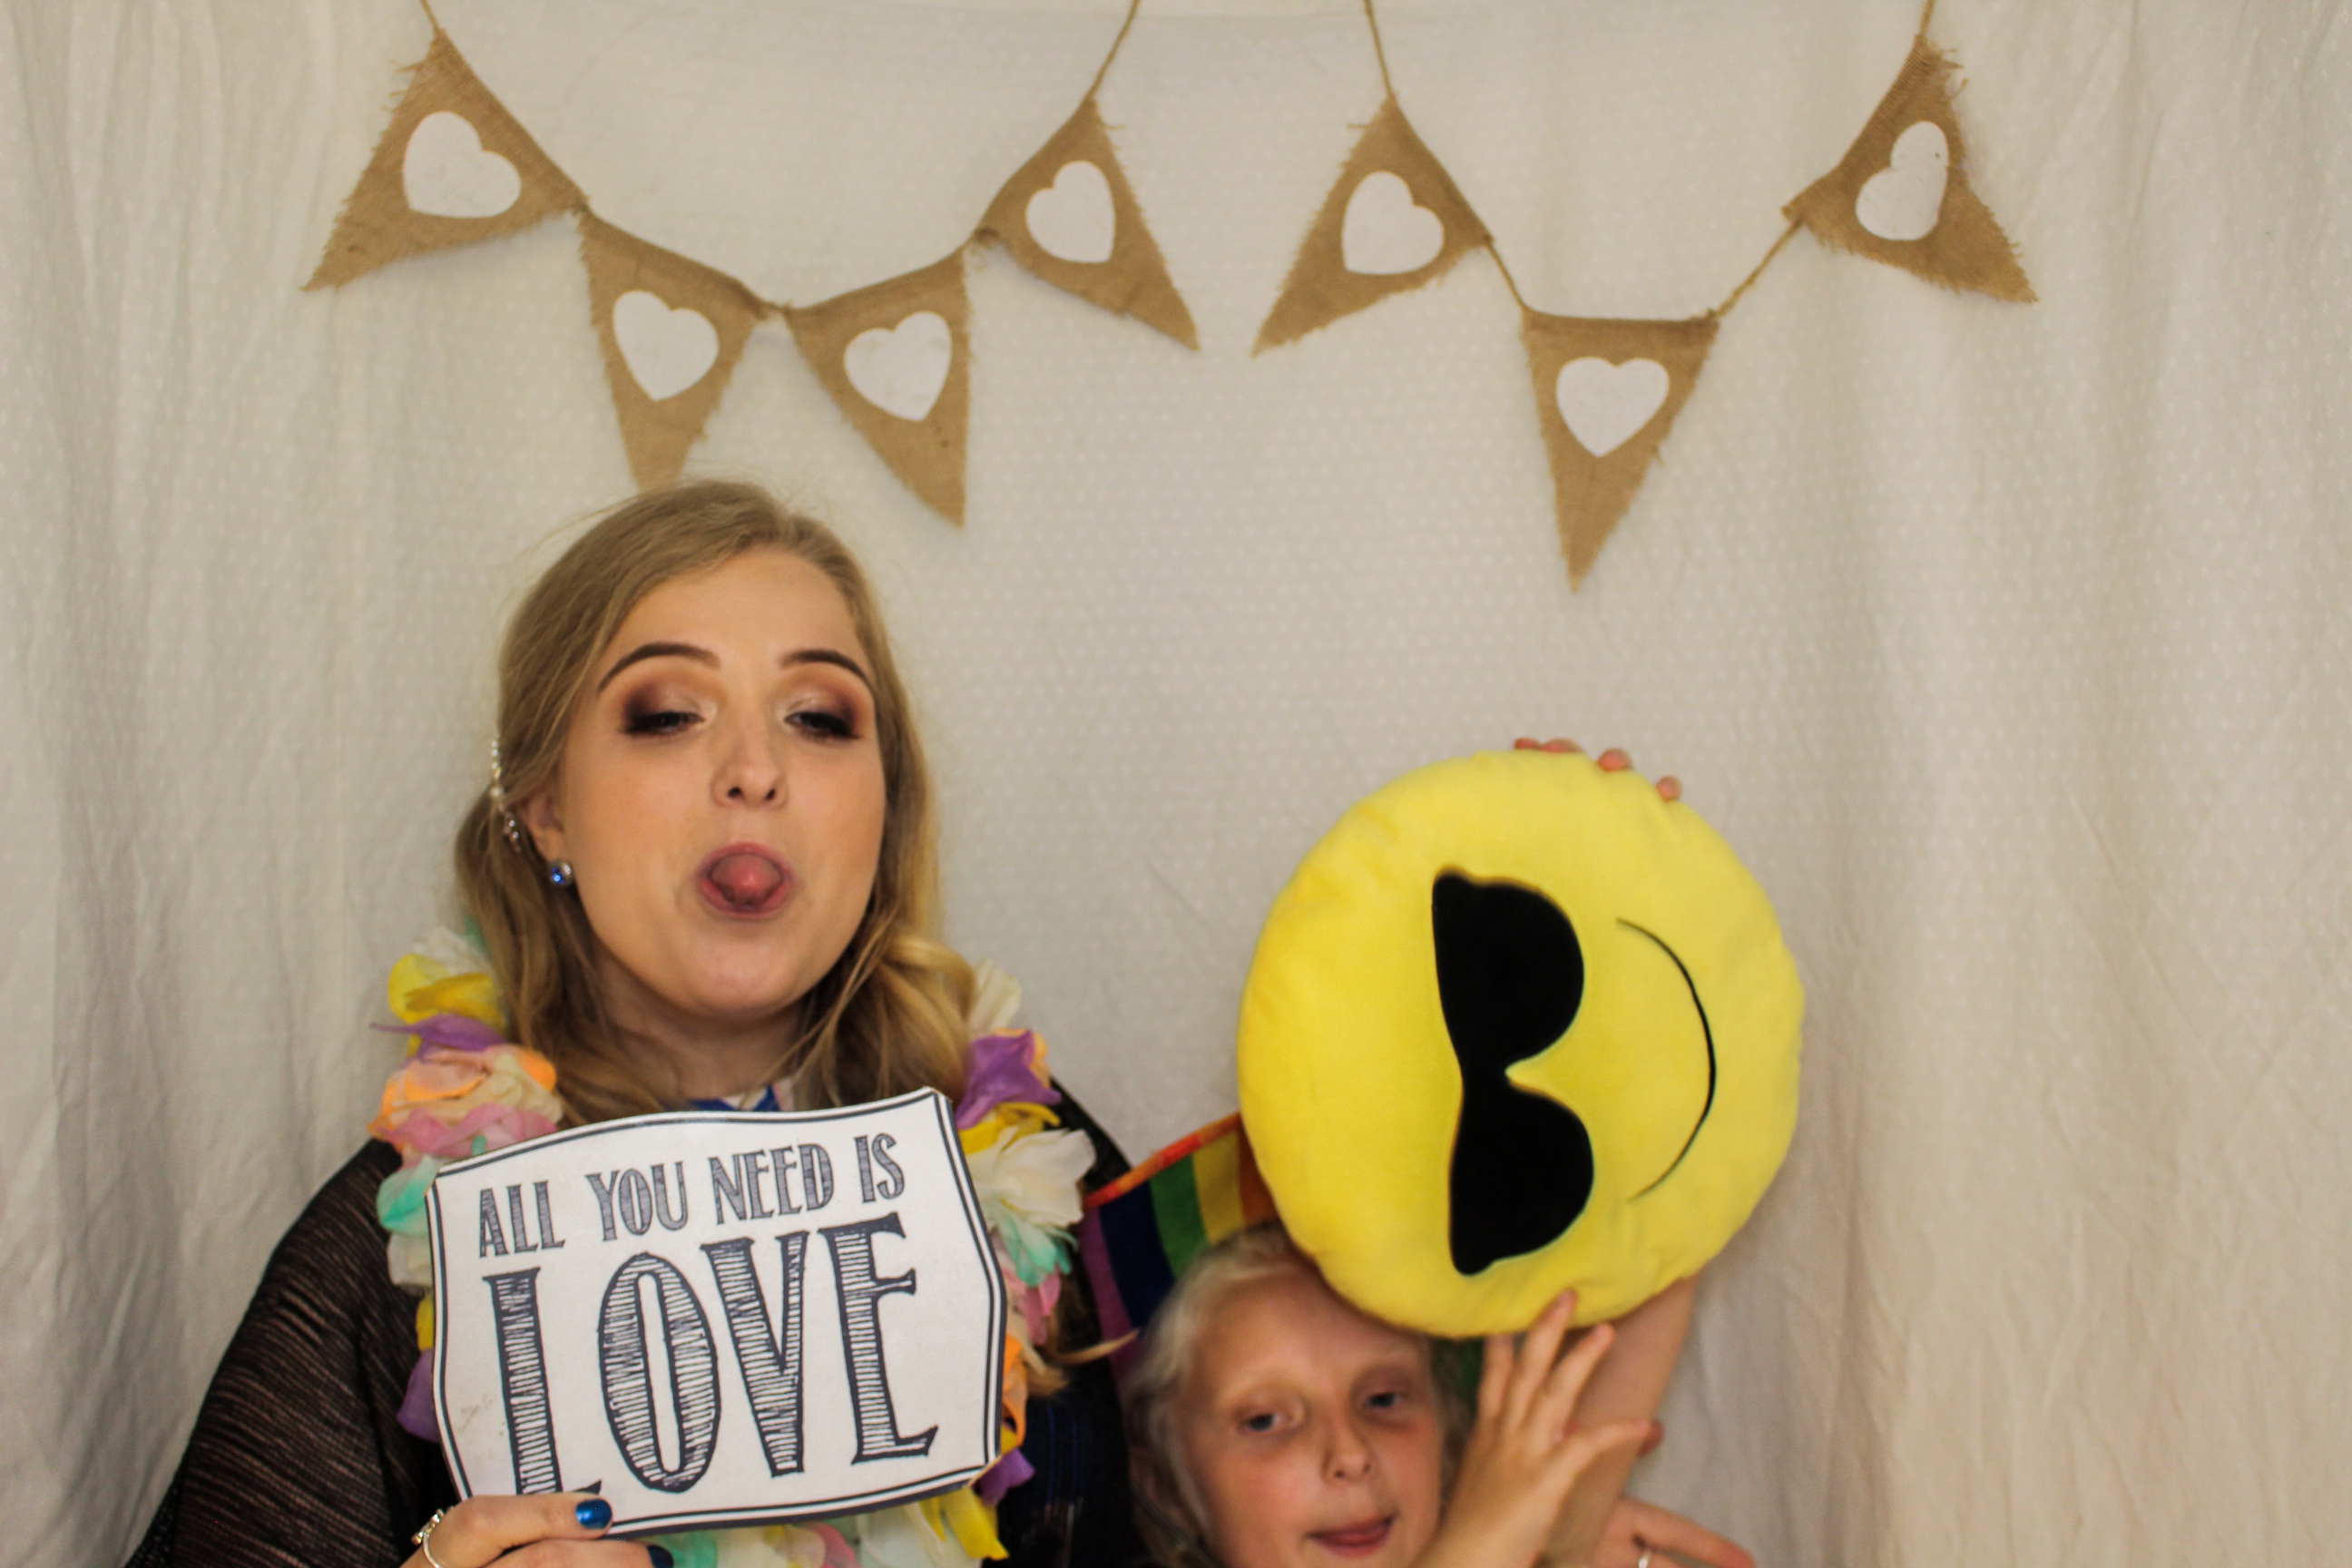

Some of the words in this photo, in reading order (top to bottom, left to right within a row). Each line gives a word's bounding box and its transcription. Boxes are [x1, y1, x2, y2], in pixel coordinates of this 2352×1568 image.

[479, 1180, 565, 1259] ALL
[584, 1161, 689, 1241] YOU
[708, 1142, 835, 1225] NEED
[853, 1132, 906, 1204] IS
[482, 1210, 939, 1496] LOVE
